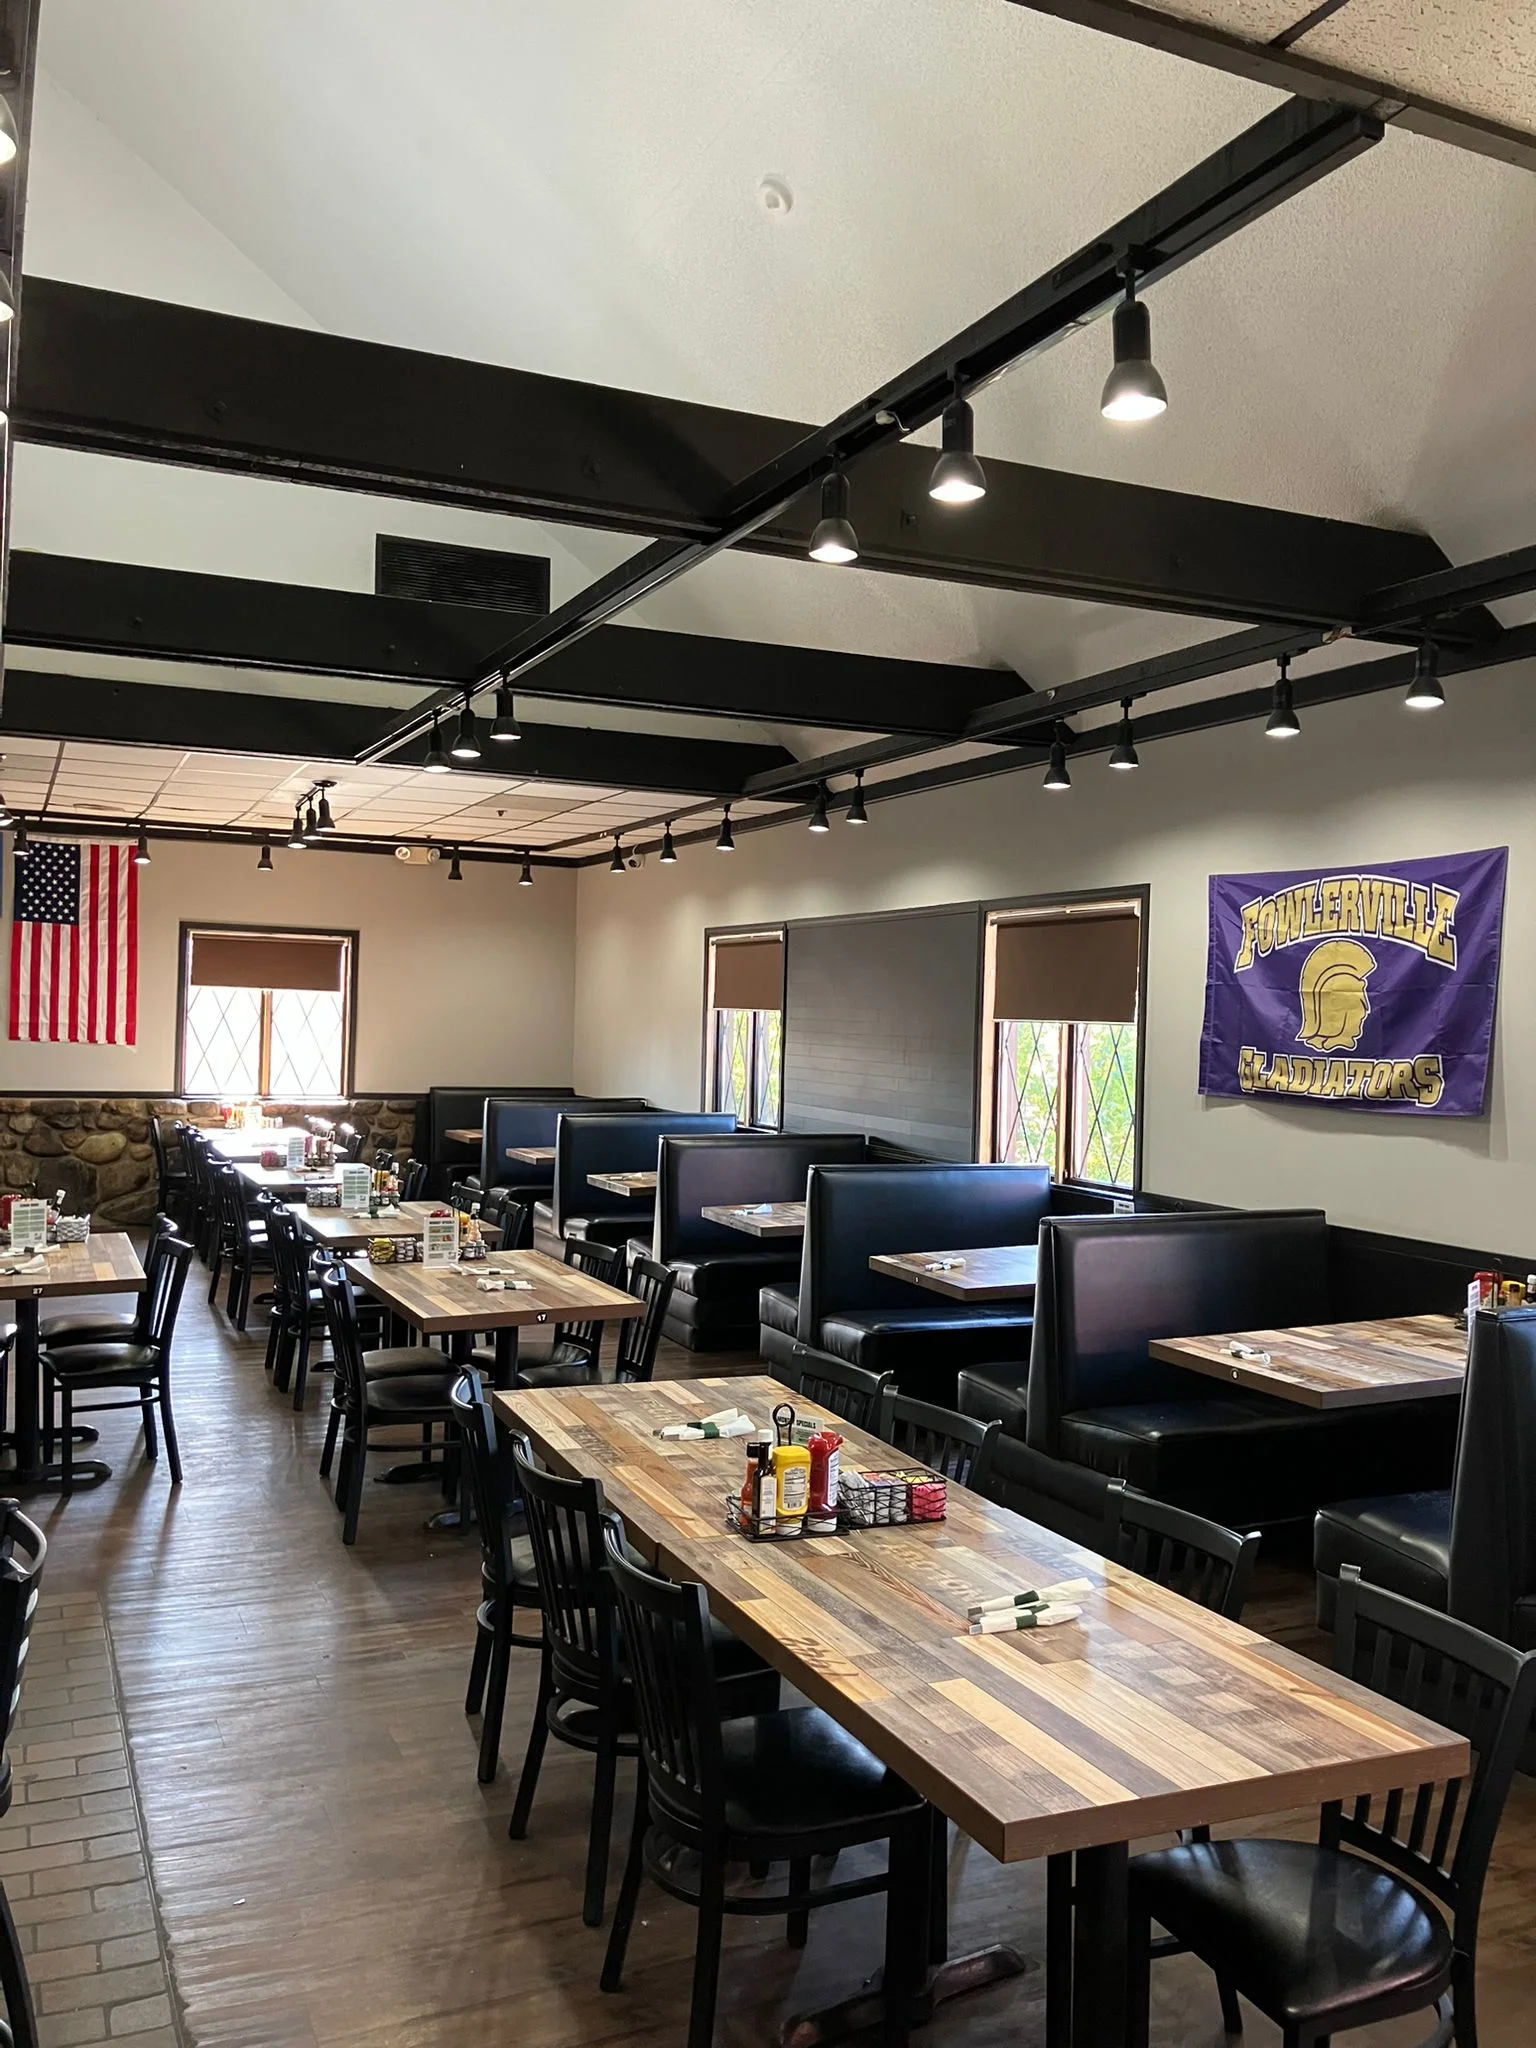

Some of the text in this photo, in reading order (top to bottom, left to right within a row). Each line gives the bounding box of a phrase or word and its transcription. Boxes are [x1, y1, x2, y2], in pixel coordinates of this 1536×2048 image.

[1234, 874, 1460, 972] FOWLERVILLE
[1238, 1046, 1444, 1107] GLADIATORS
[796, 1419, 816, 1429] SPECIALS
